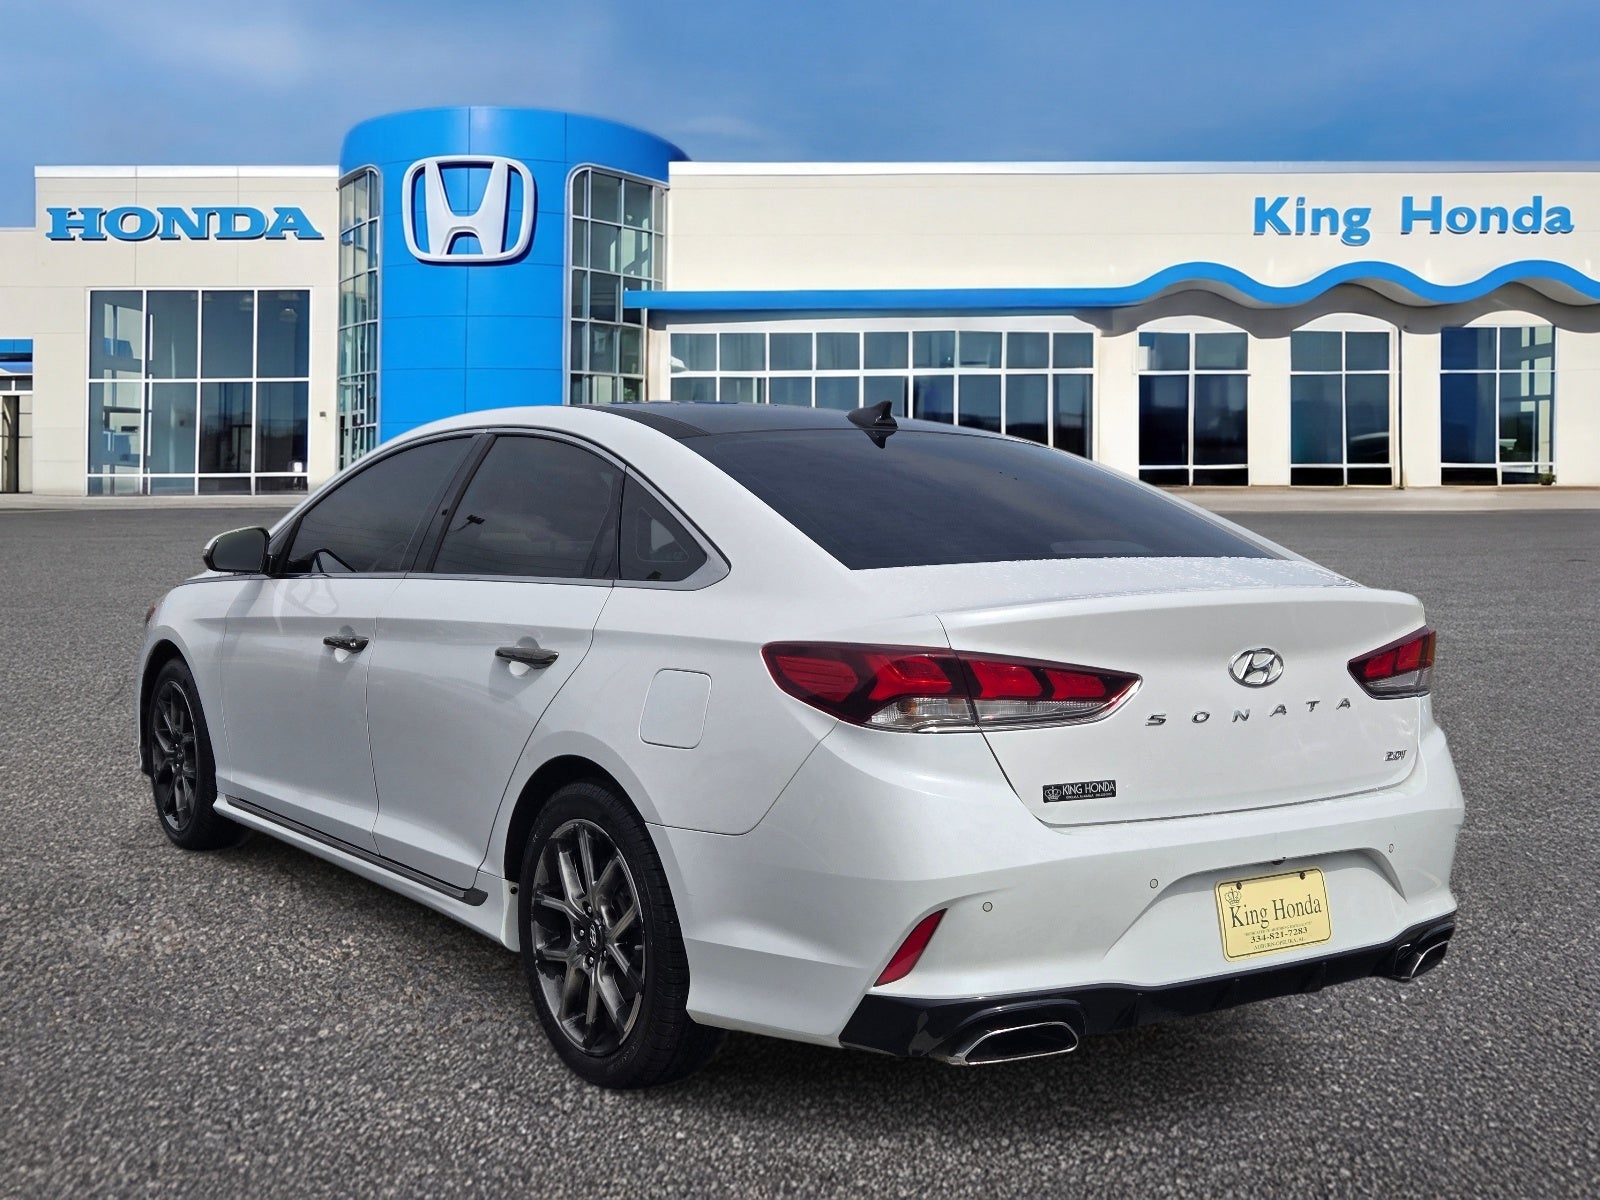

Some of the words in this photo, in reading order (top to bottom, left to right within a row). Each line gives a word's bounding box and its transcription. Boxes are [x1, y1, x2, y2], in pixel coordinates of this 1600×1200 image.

[45, 205, 325, 242] HONDA
[1253, 196, 1372, 246] King
[1400, 195, 1575, 235] Honda
[1145, 697, 1351, 726] SONATA
[1062, 783, 1083, 796] KING
[1084, 781, 1116, 794] HONDA
[1229, 903, 1270, 929] King
[1271, 894, 1322, 920] Honda
[1250, 926, 1308, 944] 334-821-7283
